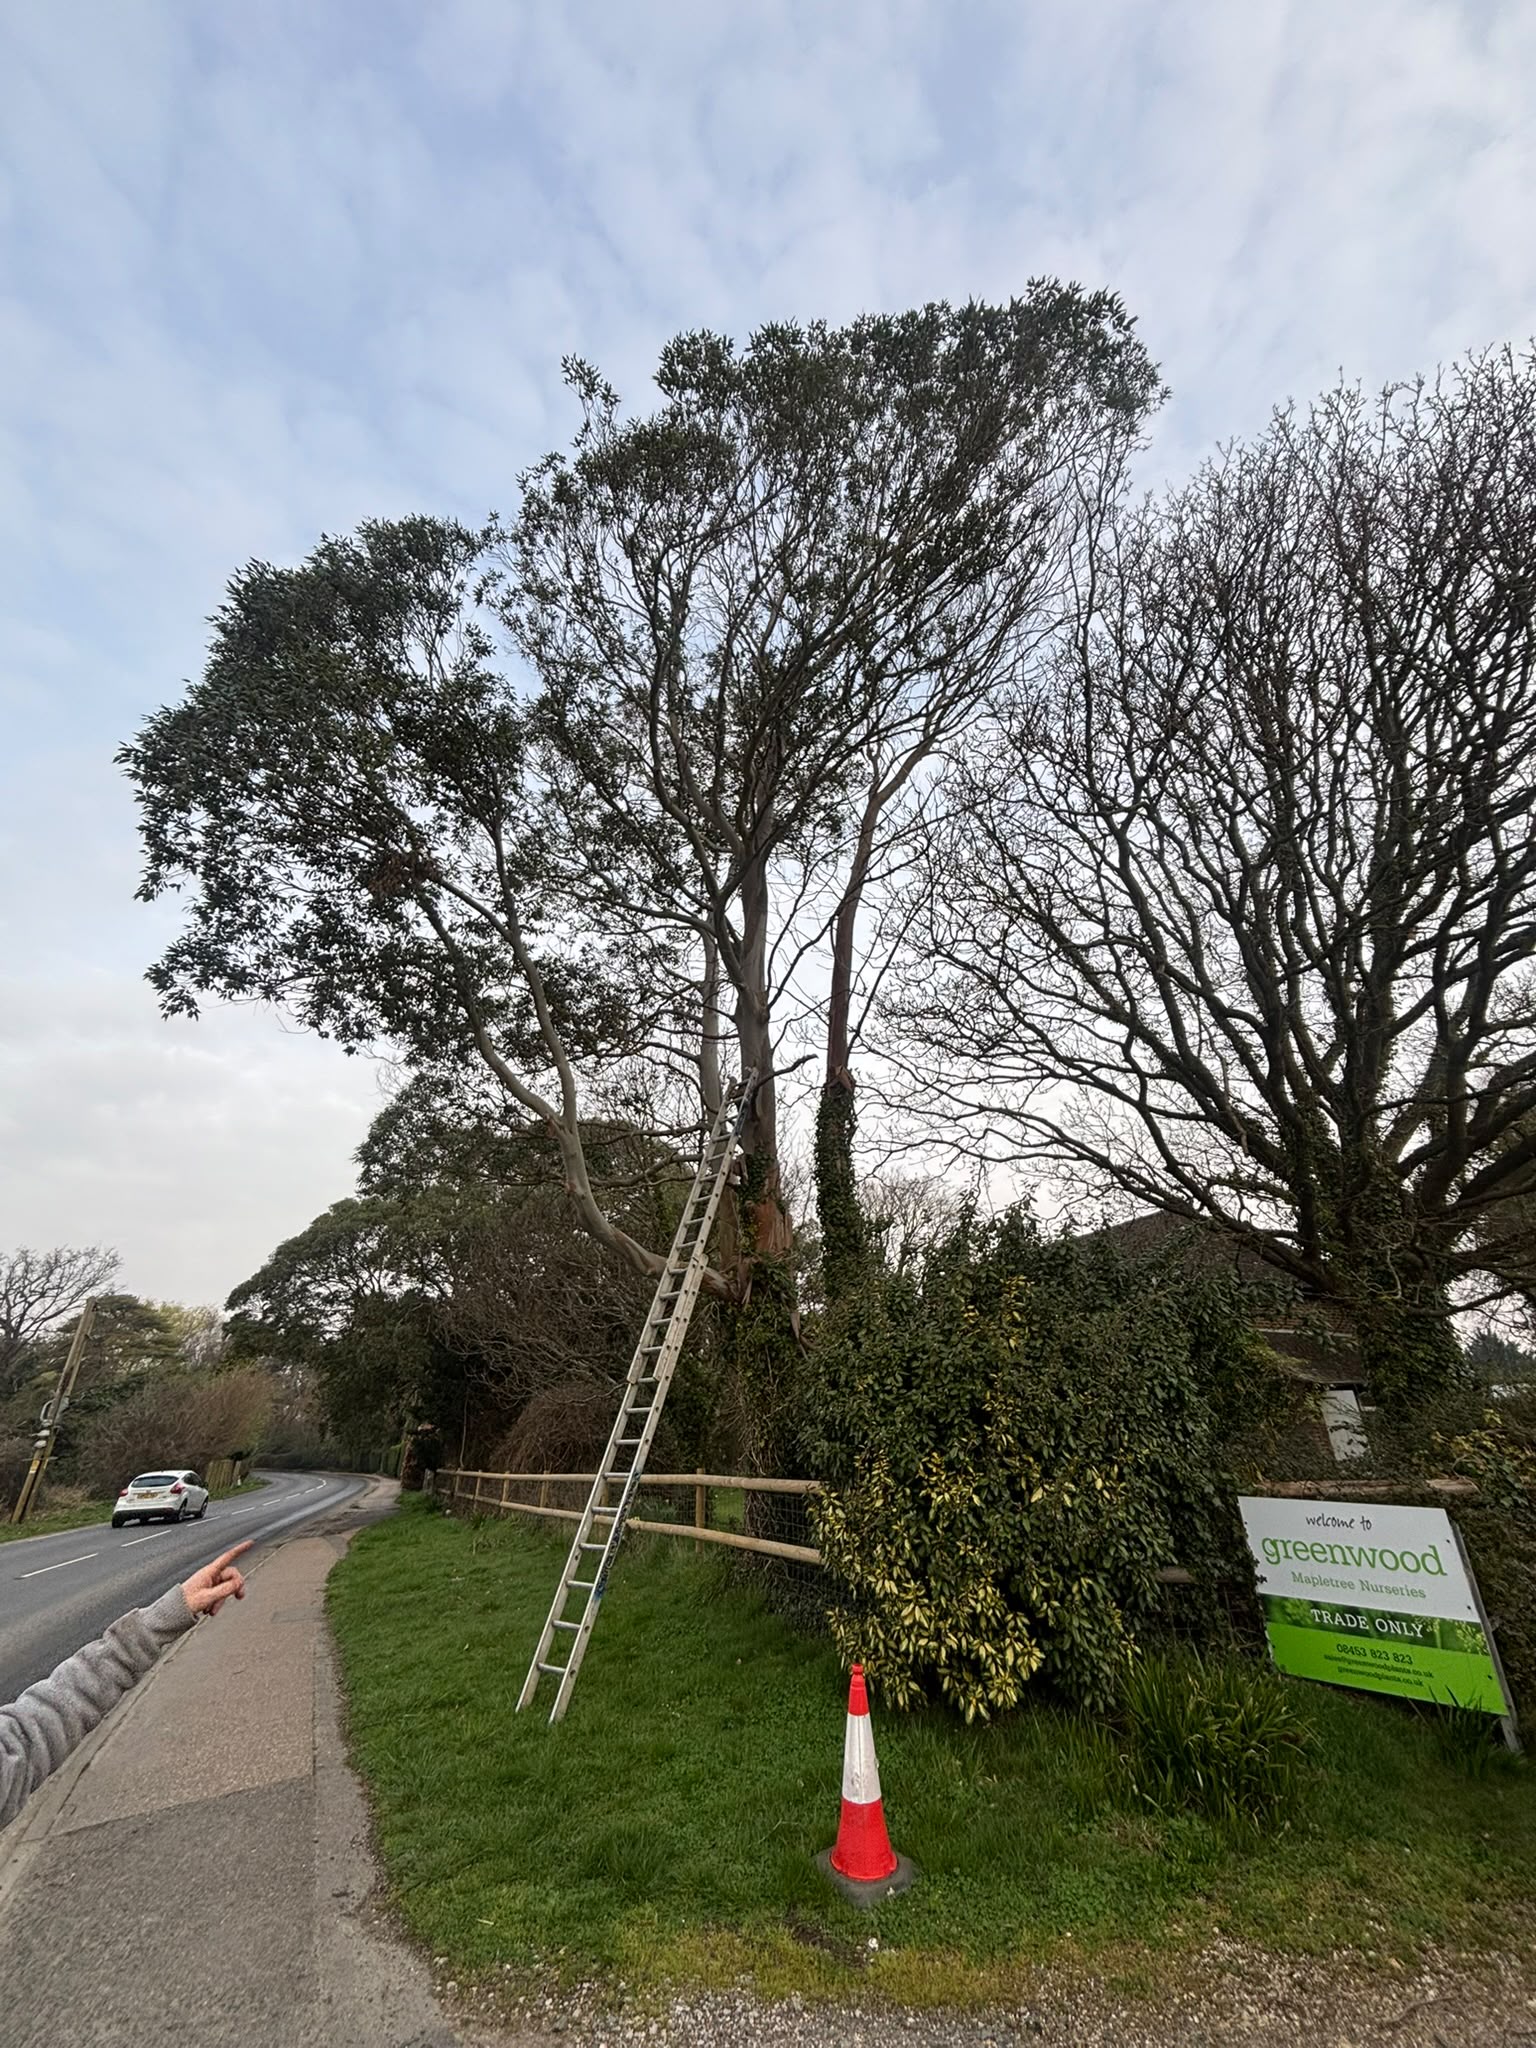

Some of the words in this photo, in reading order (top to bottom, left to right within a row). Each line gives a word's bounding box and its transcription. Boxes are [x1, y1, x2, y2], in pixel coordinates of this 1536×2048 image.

[1306, 1513, 1354, 1529] welcome
[1360, 1515, 1372, 1531] to
[1262, 1537, 1447, 1576] greenwood
[1291, 1571, 1355, 1590] Mapletree
[1359, 1579, 1426, 1598] Nurseries
[1310, 1609, 1369, 1630] TRADE
[1375, 1618, 1423, 1638] ONLY
[1337, 1643, 1367, 1657] 08453
[1370, 1648, 1390, 1661] 823
[1392, 1652, 1413, 1665] 823
